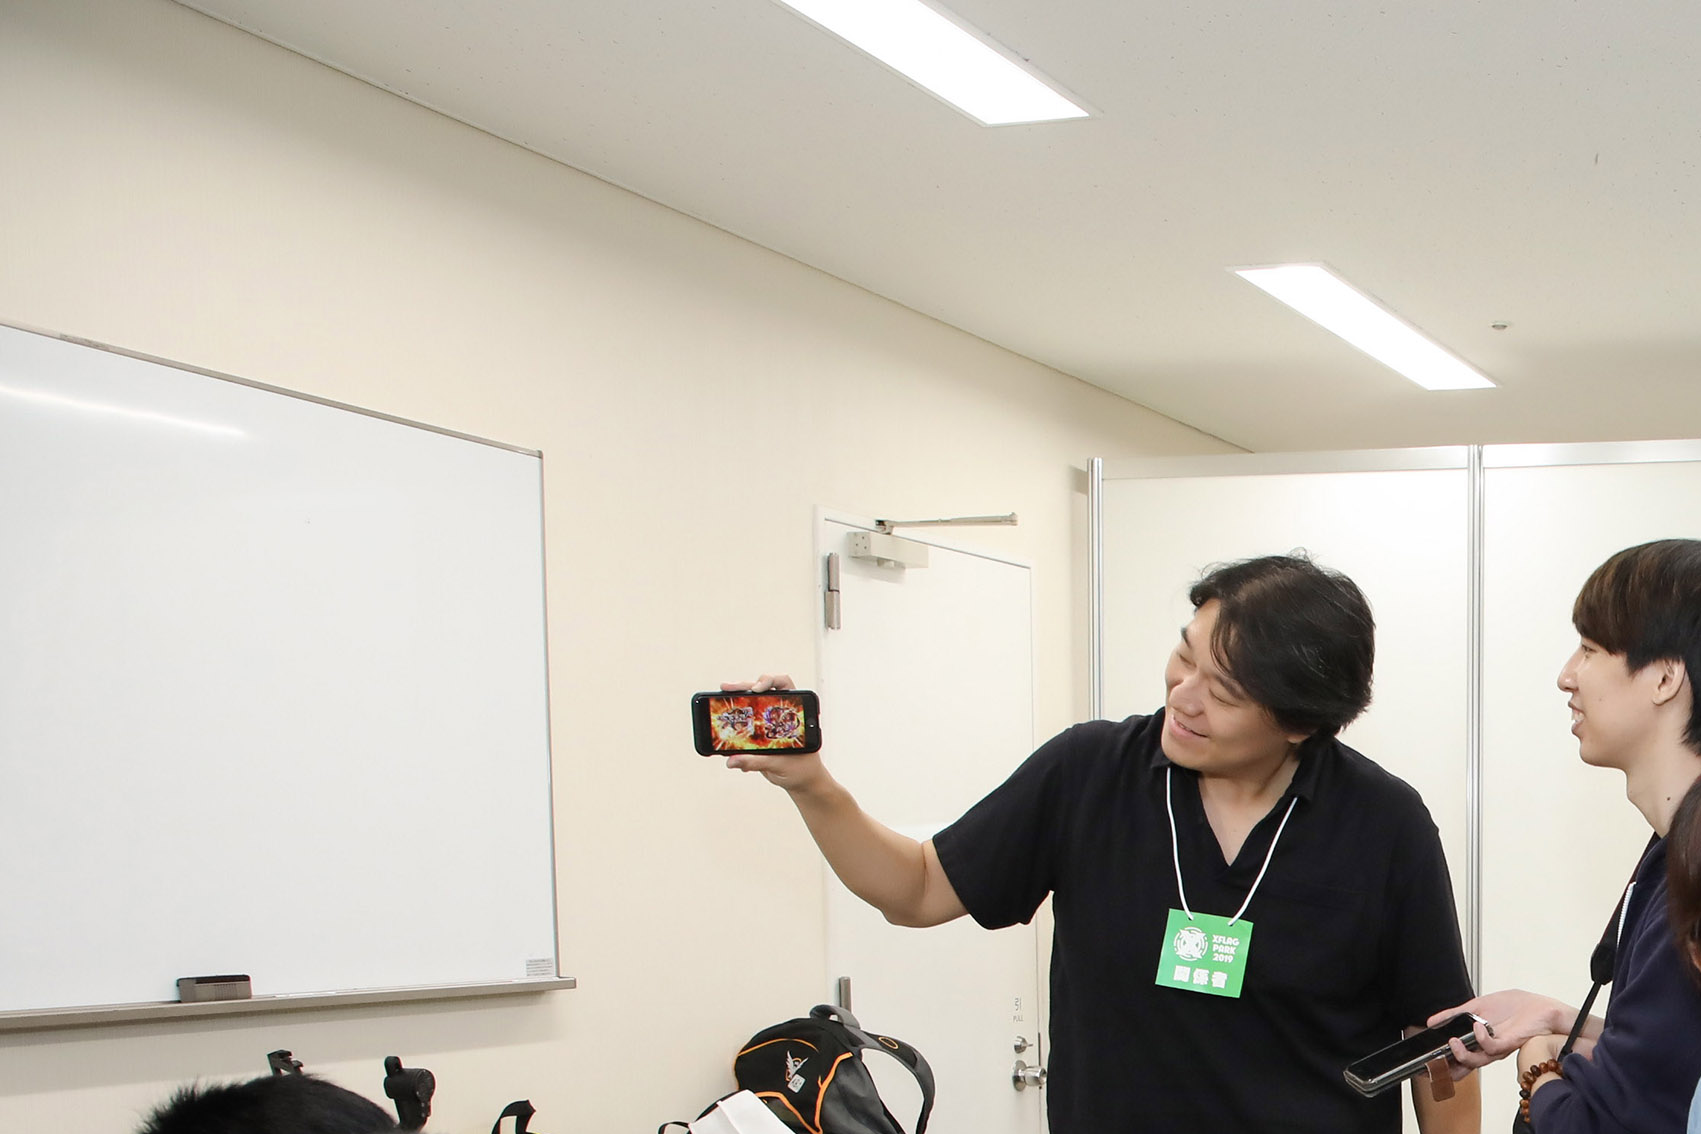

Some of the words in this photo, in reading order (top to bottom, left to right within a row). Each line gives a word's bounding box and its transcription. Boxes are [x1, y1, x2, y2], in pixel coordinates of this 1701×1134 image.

[1212, 934, 1240, 946] XFLAG
[1212, 944, 1237, 955] PARK
[1212, 953, 1234, 963] 2019
